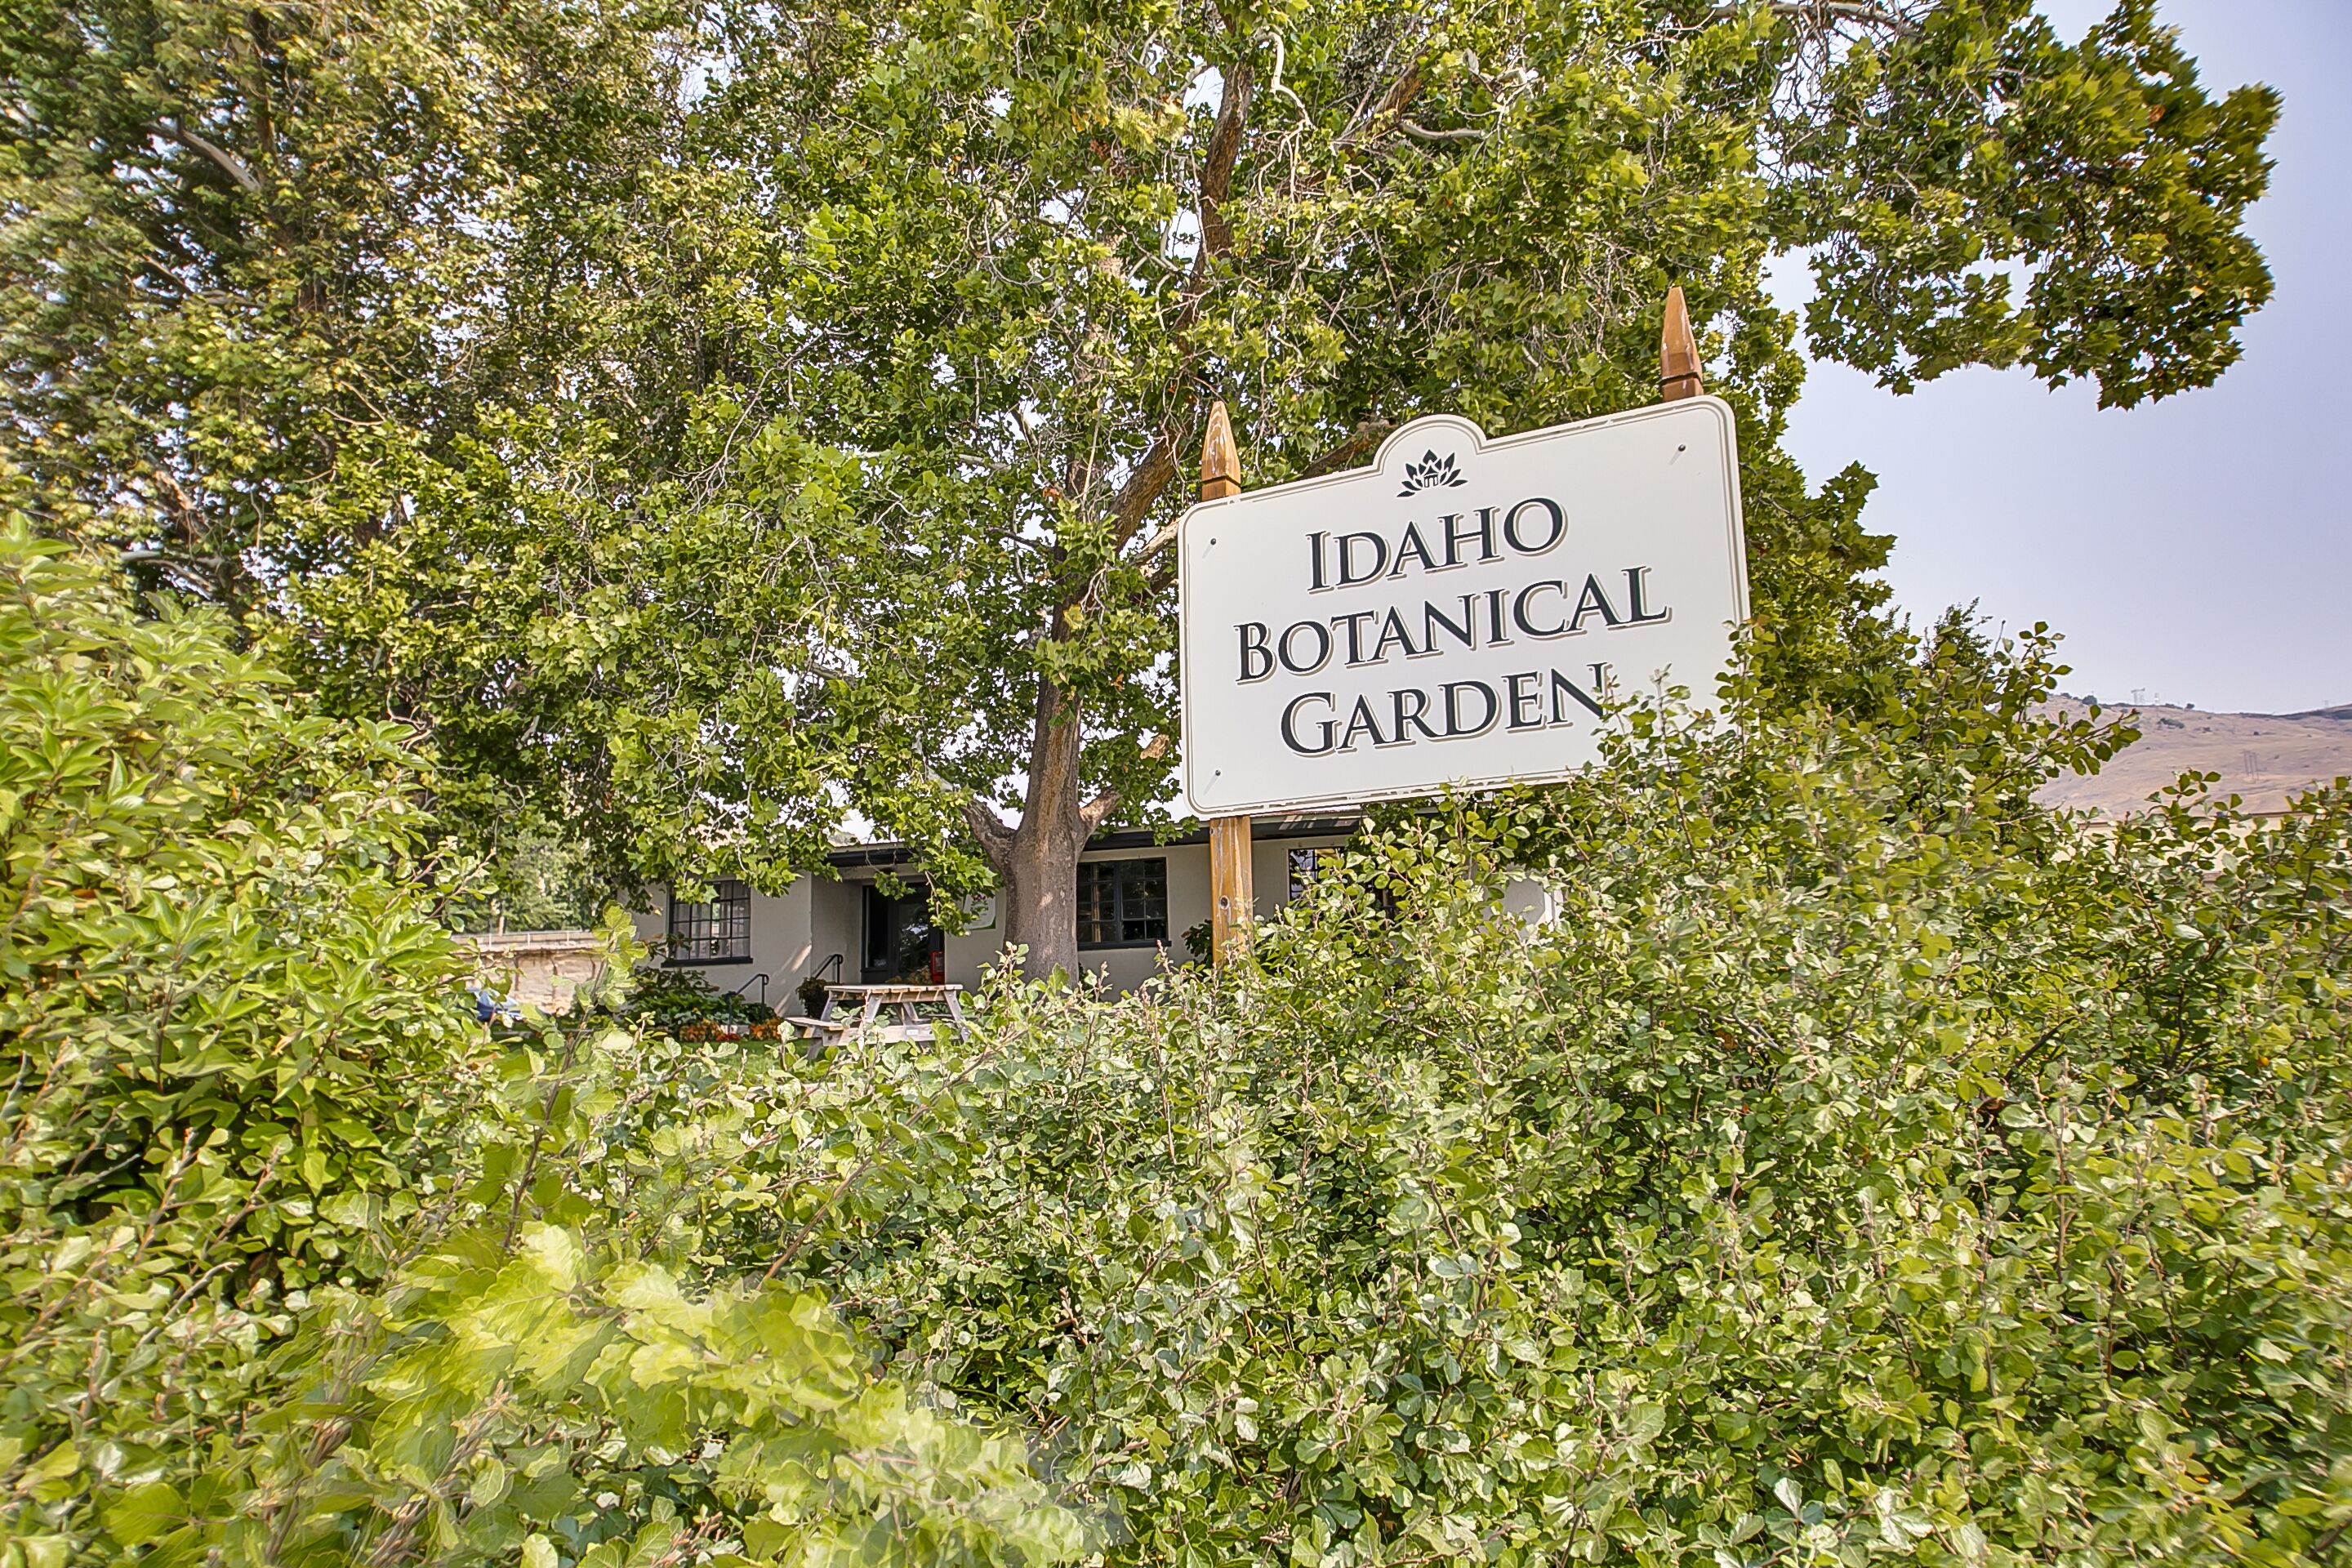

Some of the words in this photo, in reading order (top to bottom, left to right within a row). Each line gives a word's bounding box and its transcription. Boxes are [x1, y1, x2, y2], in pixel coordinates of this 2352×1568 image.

[1305, 497, 1566, 594] IDAHO
[1233, 566, 1670, 684] BOTANICAL
[1280, 662, 1610, 755] GARDEN
